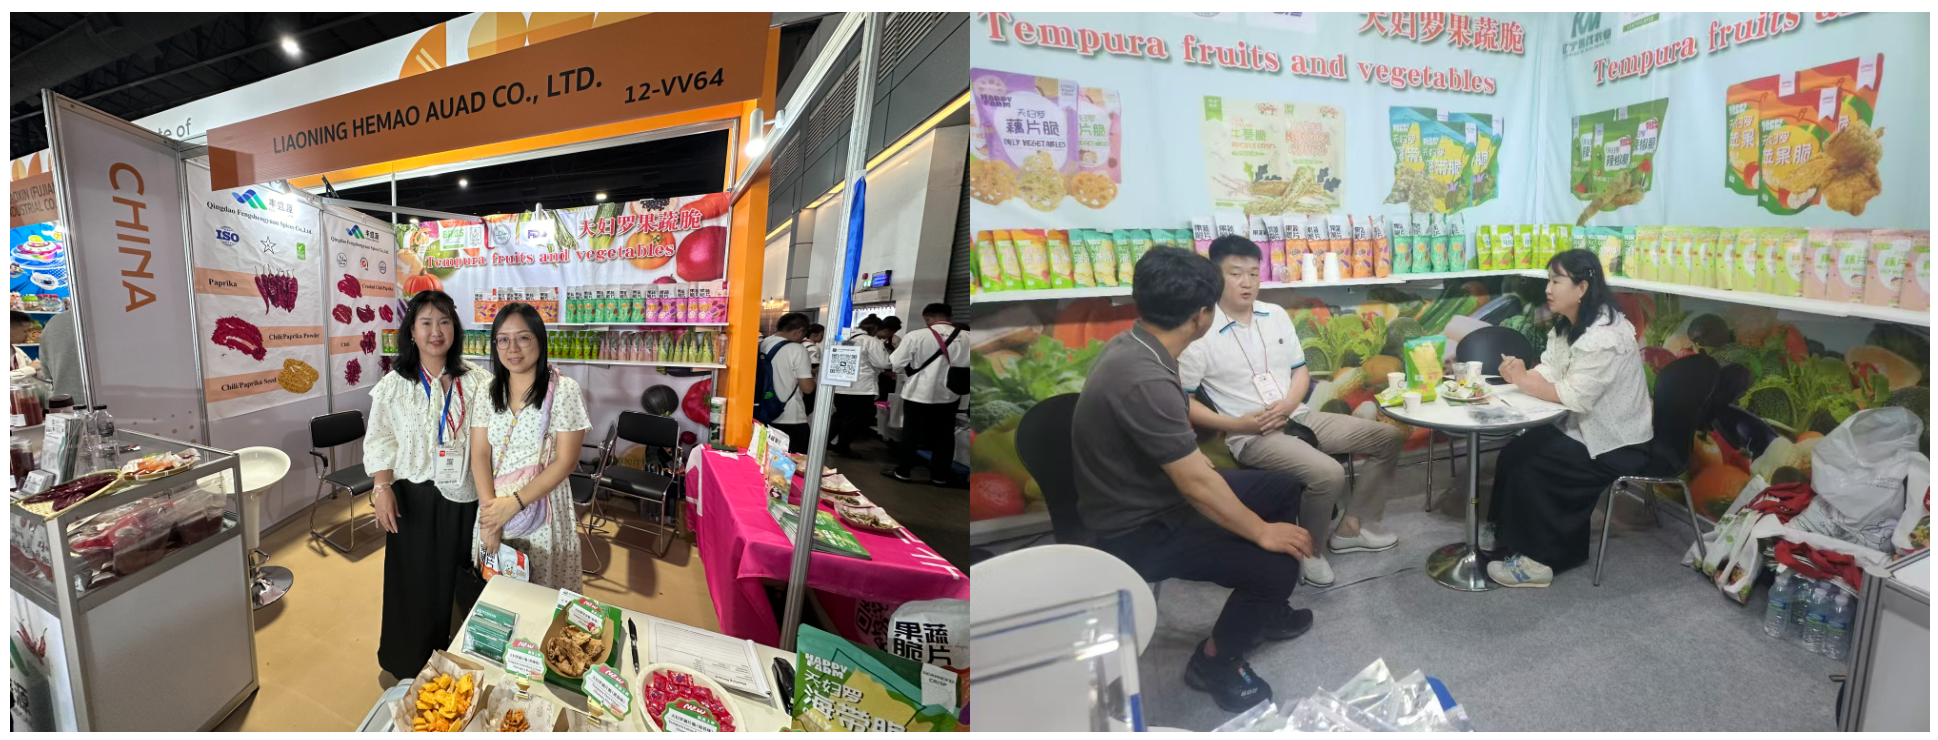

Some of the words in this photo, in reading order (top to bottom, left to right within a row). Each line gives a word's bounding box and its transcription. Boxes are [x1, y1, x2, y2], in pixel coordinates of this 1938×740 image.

[975, 12, 1168, 58] Tempura
[1182, 33, 1280, 73] fruits
[1290, 52, 1347, 80] and
[1357, 61, 1496, 94] vegetables
[1593, 36, 1696, 84] Tempura
[1708, 12, 1801, 53] fruits
[624, 68, 724, 104] 12-VV64
[980, 94, 1012, 102] HAPPY
[273, 121, 348, 154] LIAONING
[352, 105, 420, 138] HEMAO
[425, 91, 486, 123] AUAD
[492, 82, 538, 108] CO.,
[547, 66, 602, 98] LTD.
[1017, 108, 1045, 119] 天妇罗
[176, 117, 192, 138] of
[1006, 118, 1060, 137] 藕片脆
[1003, 138, 1020, 147] ONLY
[1022, 138, 1066, 149] VEGETABLES
[1763, 143, 1813, 166] 苹果脆
[206, 201, 236, 215] Qingdao
[578, 208, 702, 238] 天妇罗果蔬脆
[109, 162, 157, 313] CHINA
[216, 229, 240, 243] ISO
[425, 255, 486, 268] Tempura
[492, 252, 533, 267] fruits
[539, 248, 569, 263] and
[575, 243, 675, 262] vegetables
[208, 278, 237, 288] Paprika
[221, 379, 263, 392] Chili/Paprika
[894, 621, 948, 644] 果蔬
[805, 653, 848, 674] HAPPY
[605, 670, 624, 684] NEW
[804, 669, 864, 704] 天妇罗
[922, 671, 955, 684] SEAWEED
[928, 678, 947, 686] CRISP
[683, 703, 706, 715] NEW
